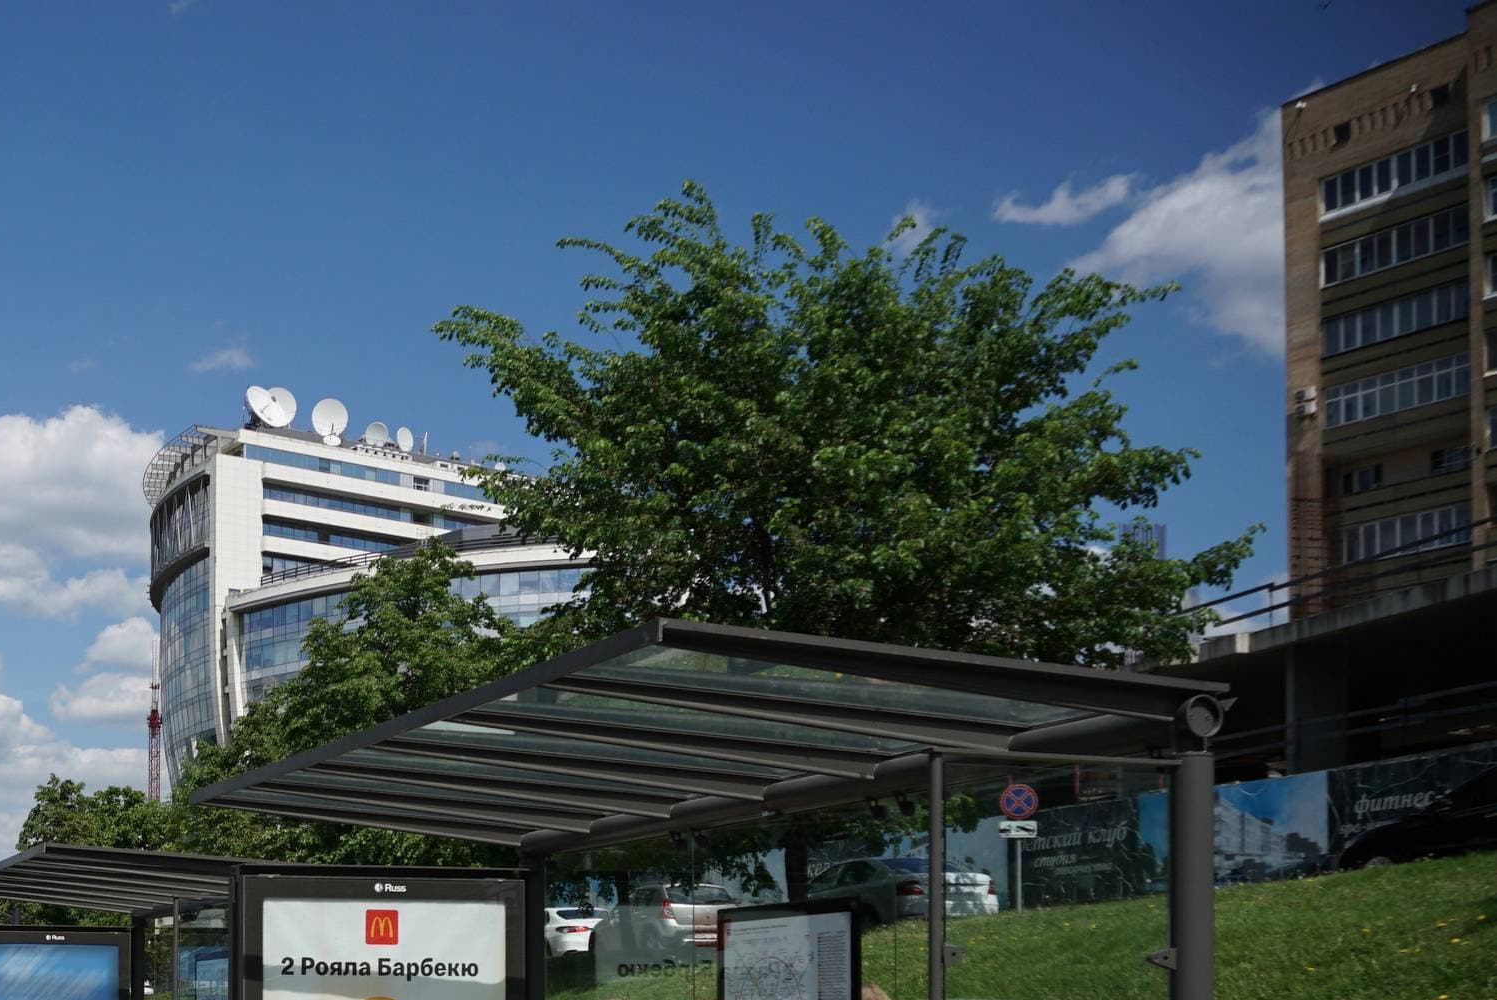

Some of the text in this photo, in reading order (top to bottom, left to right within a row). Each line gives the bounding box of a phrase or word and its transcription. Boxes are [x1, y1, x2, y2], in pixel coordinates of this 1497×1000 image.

[1088, 821, 1127, 847] клуб
[384, 883, 407, 893] Russ
[281, 956, 479, 981] 2 Рояла Барбекю
